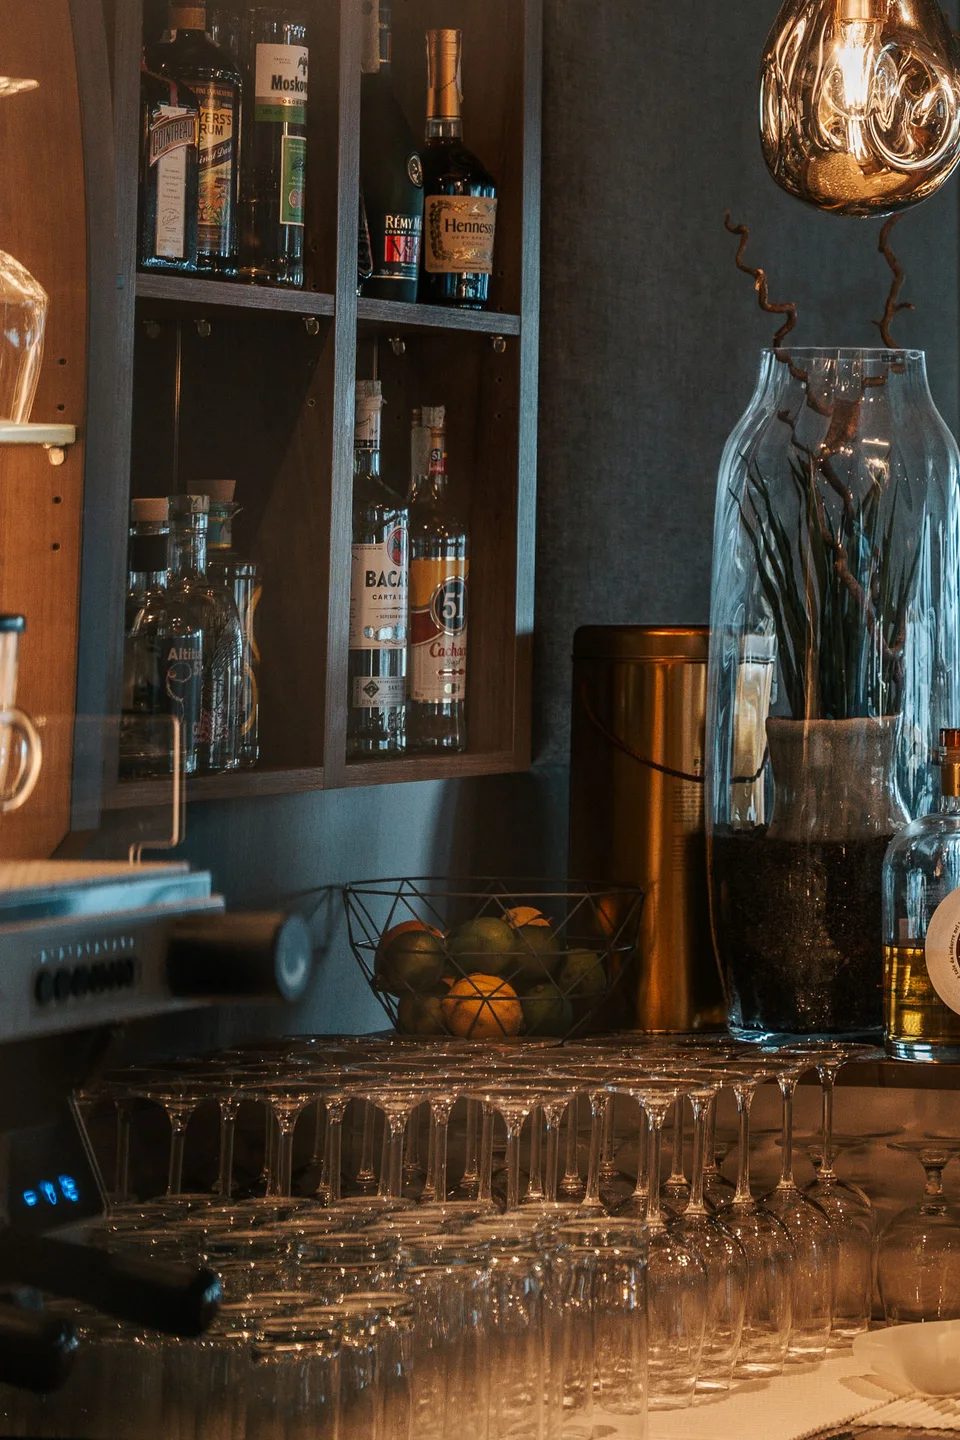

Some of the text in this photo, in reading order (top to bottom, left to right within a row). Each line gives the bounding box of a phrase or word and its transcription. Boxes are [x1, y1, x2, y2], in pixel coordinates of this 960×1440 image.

[152, 118, 194, 155] COINTREAU
[200, 124, 224, 137] RUM
[385, 215, 413, 229] RÉMY
[431, 451, 441, 459] 51
[442, 590, 465, 621] 51
